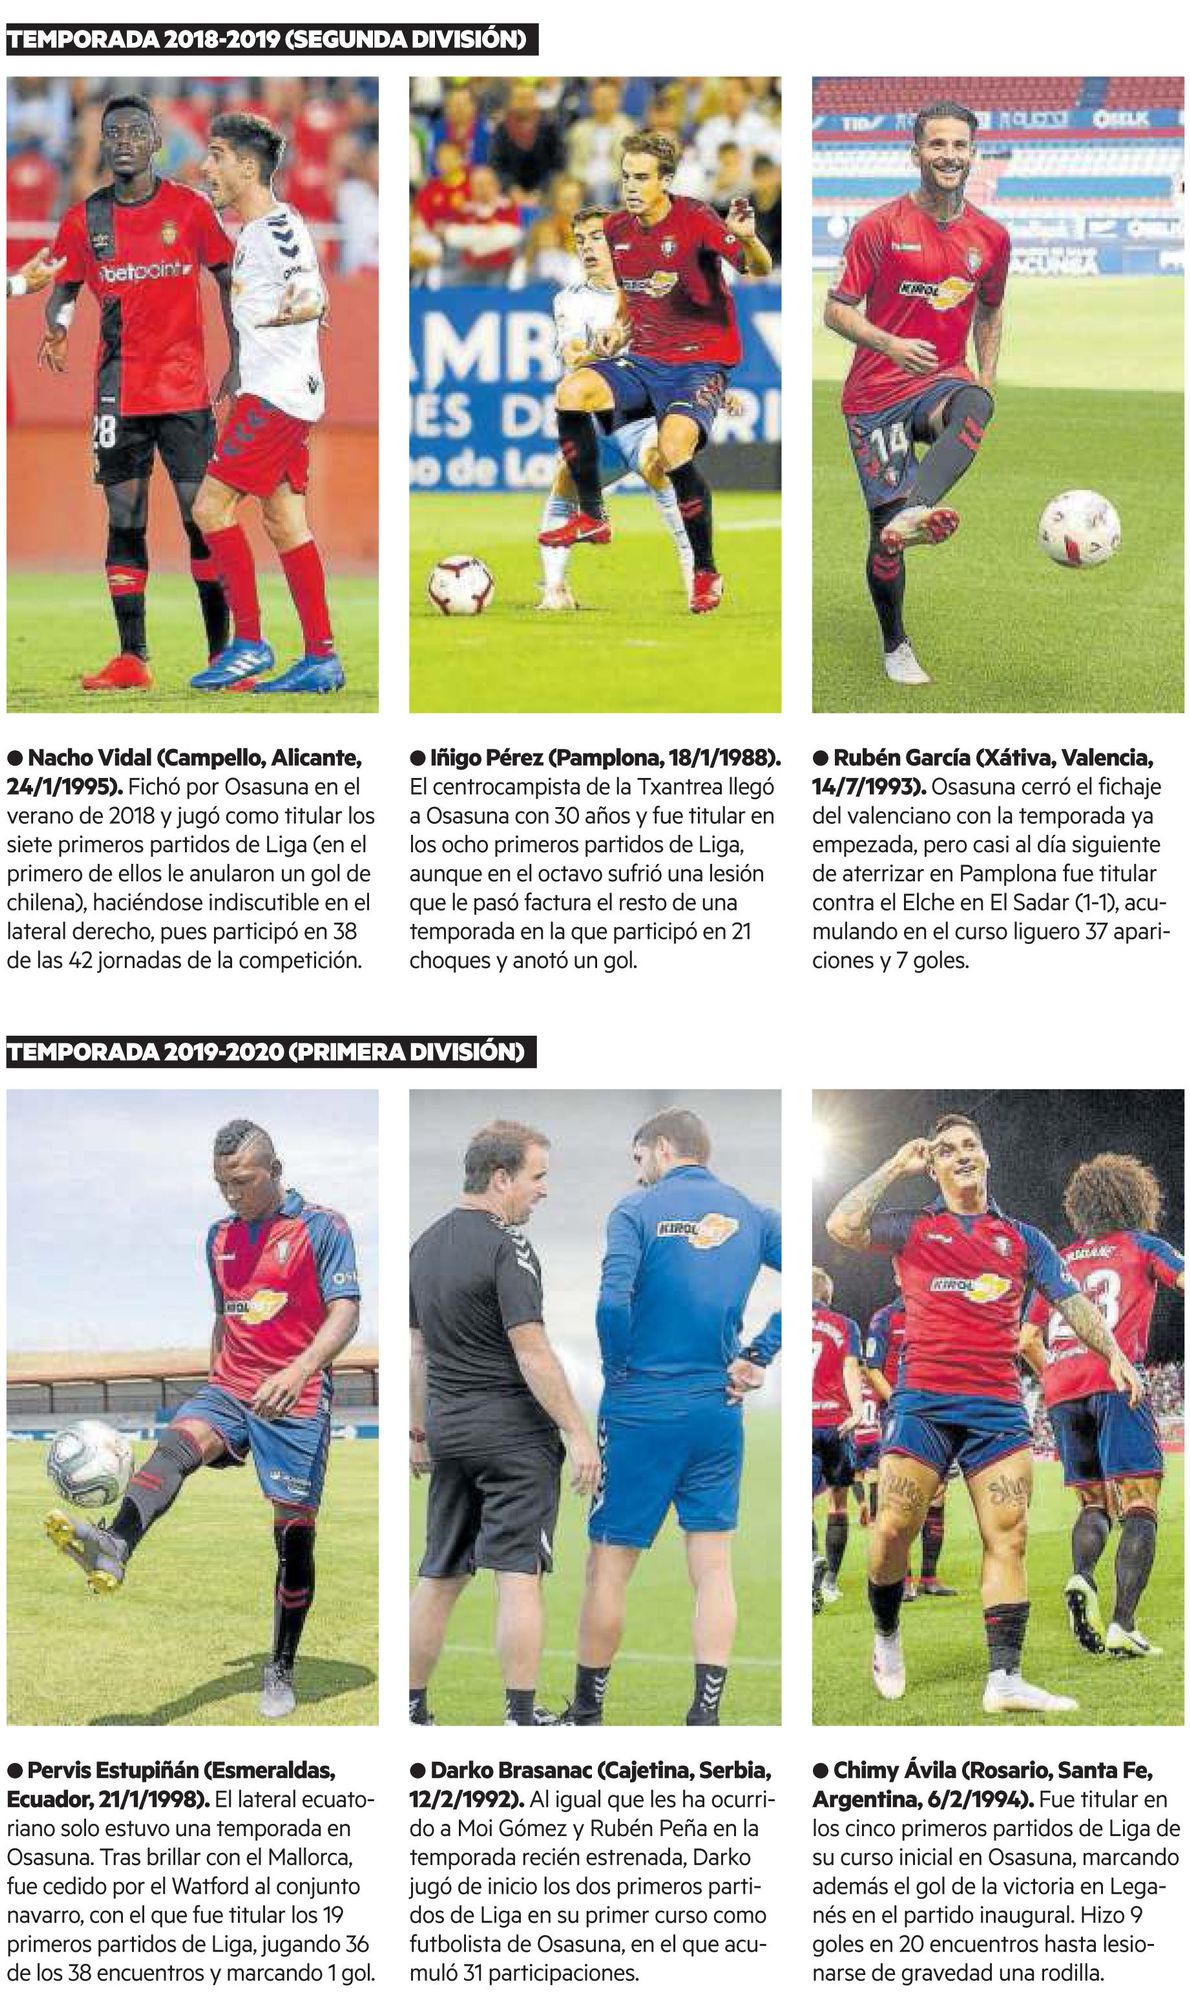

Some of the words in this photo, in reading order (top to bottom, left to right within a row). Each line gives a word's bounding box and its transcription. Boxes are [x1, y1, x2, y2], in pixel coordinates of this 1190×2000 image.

[8, 30, 160, 48] TEMPORADA
[164, 30, 281, 48] 2018-2019
[285, 29, 408, 50] (SEGUNDA
[413, 25, 526, 50] DIVISIÓN)
[870, 421, 908, 461] 14
[28, 747, 94, 767] Nacho
[97, 747, 152, 767] Vidal
[156, 747, 267, 771] (Campello,
[270, 747, 363, 769] Alicante,
[430, 747, 483, 771] Iñigo
[486, 747, 545, 767] Pérez
[548, 747, 666, 771] (Pamplona,
[668, 747, 782, 769] 18/1/1988).
[834, 747, 901, 767] Rubén
[905, 747, 971, 767] García
[975, 747, 1058, 769] (Xátiva,
[1060, 747, 1154, 769] Valencia,
[6, 776, 124, 798] 24/1/1995).
[128, 776, 181, 796] Fichó
[186, 781, 220, 800] por
[224, 776, 309, 796] Osasuna
[314, 781, 338, 796] en
[343, 776, 360, 796] el
[410, 776, 427, 796] El
[432, 777, 581, 800] centrocampista
[586, 776, 611, 796] de
[616, 776, 632, 796] la
[636, 777, 723, 796] Txantrea
[729, 776, 775, 800] llegó
[812, 805, 842, 825] del
[847, 805, 952, 825] valenciano
[956, 810, 991, 825] con
[997, 805, 1013, 825] la
[1018, 805, 1125, 829] temporada
[1131, 810, 1154, 829] ya
[409, 868, 483, 887] aunque
[487, 868, 511, 883] en
[516, 863, 533, 883] el
[537, 865, 603, 883] octavo
[608, 862, 663, 883] sufrió
[668, 868, 703, 883] una
[709, 863, 764, 883] lesión
[812, 863, 837, 883] de
[842, 863, 925, 883] aterrizar
[929, 868, 954, 883] en
[960, 863, 1057, 887] Pamplona
[1062, 862, 1094, 883] fue
[1098, 863, 1158, 883] titular
[6, 892, 88, 914] chilena),
[93, 892, 204, 912] haciéndose
[208, 892, 320, 912] indiscutible
[324, 897, 349, 912] en
[354, 892, 370, 912] el
[7, 920, 66, 941] lateral
[72, 920, 155, 943] derecho,
[160, 926, 208, 945] pues
[213, 920, 299, 945] participó
[303, 926, 328, 941] en
[333, 921, 358, 941] 38
[409, 949, 491, 974] choques
[495, 955, 509, 974] y
[512, 949, 569, 970] anotó
[574, 955, 598, 970] un
[603, 949, 638, 974] gol.
[812, 950, 875, 970] ciones
[879, 955, 892, 974] y
[896, 950, 909, 969] 7
[913, 949, 970, 974] goles.
[8, 1043, 160, 1061] TEMPORADA
[165, 1043, 284, 1061] 2019-2020
[289, 1042, 406, 1063] (PRIMERA
[411, 1038, 524, 1063] DIVISIÓN)
[27, 1759, 92, 1780] Pervis
[96, 1759, 200, 1783] Estupiñán
[203, 1759, 336, 1782] (Esmeraldas,
[431, 1759, 495, 1780] Darko
[498, 1760, 593, 1780] Brasanac
[597, 1759, 696, 1784] (Cajetina,
[699, 1759, 772, 1782] Serbia,
[833, 1759, 900, 1783] Chimy
[903, 1755, 957, 1779] Ávila
[961, 1759, 1054, 1782] (Rosario,
[1057, 1760, 1118, 1780] Santa
[1123, 1760, 1154, 1782] Fe,
[7, 1789, 95, 1811] Ecuador,
[98, 1788, 211, 1811] 21/1/1998).
[215, 1789, 232, 1808] El
[238, 1788, 296, 1809] lateral
[301, 1791, 375, 1809] ecuato-
[811, 1788, 924, 1813] Argentina,
[927, 1788, 1035, 1811] 6/2/1994).
[1039, 1789, 1076, 1809] Fue
[1080, 1788, 1139, 1809] titular
[1143, 1794, 1168, 1809] en
[6, 1847, 95, 1866] Osasuna.
[99, 1847, 141, 1866] Tras
[147, 1846, 202, 1866] brillar
[206, 1852, 241, 1866] con
[246, 1847, 262, 1866] el
[268, 1846, 353, 1869] Mallorca,
[409, 1846, 516, 1871] temporada
[522, 1846, 580, 1866] recién
[585, 1846, 688, 1869] estrenada,
[693, 1846, 752, 1866] Darko
[408, 1875, 453, 1900] jugó
[457, 1875, 483, 1896] de
[487, 1876, 538, 1896] inicio
[543, 1875, 571, 1896] los
[575, 1875, 611, 1896] dos
[617, 1876, 703, 1900] primeros
[708, 1876, 762, 1900] parti-
[812, 1875, 889, 1896] además
[893, 1875, 910, 1896] el
[915, 1875, 946, 1900] gol
[951, 1875, 976, 1896] de
[981, 1875, 998, 1895] la
[1002, 1876, 1075, 1896] victoria
[1080, 1881, 1104, 1896] en
[1110, 1876, 1167, 1900] Lega-
[6, 1962, 32, 1982] de
[36, 1962, 63, 1982] los
[68, 1963, 92, 1982] 38
[96, 1964, 205, 1982] encuentros
[209, 1967, 222, 1986] y
[227, 1962, 323, 1982] marcando
[327, 1963, 336, 1982] 1
[341, 1962, 376, 1986] gol.
[410, 1962, 459, 1982] muló
[463, 1963, 482, 1982] 31
[488, 1963, 640, 1986] participaciones.
[813, 1967, 867, 1982] narse
[871, 1962, 896, 1982] de
[901, 1962, 993, 1986] gravedad
[999, 1967, 1035, 1982] una
[1041, 1962, 1105, 1982] rodilla.
